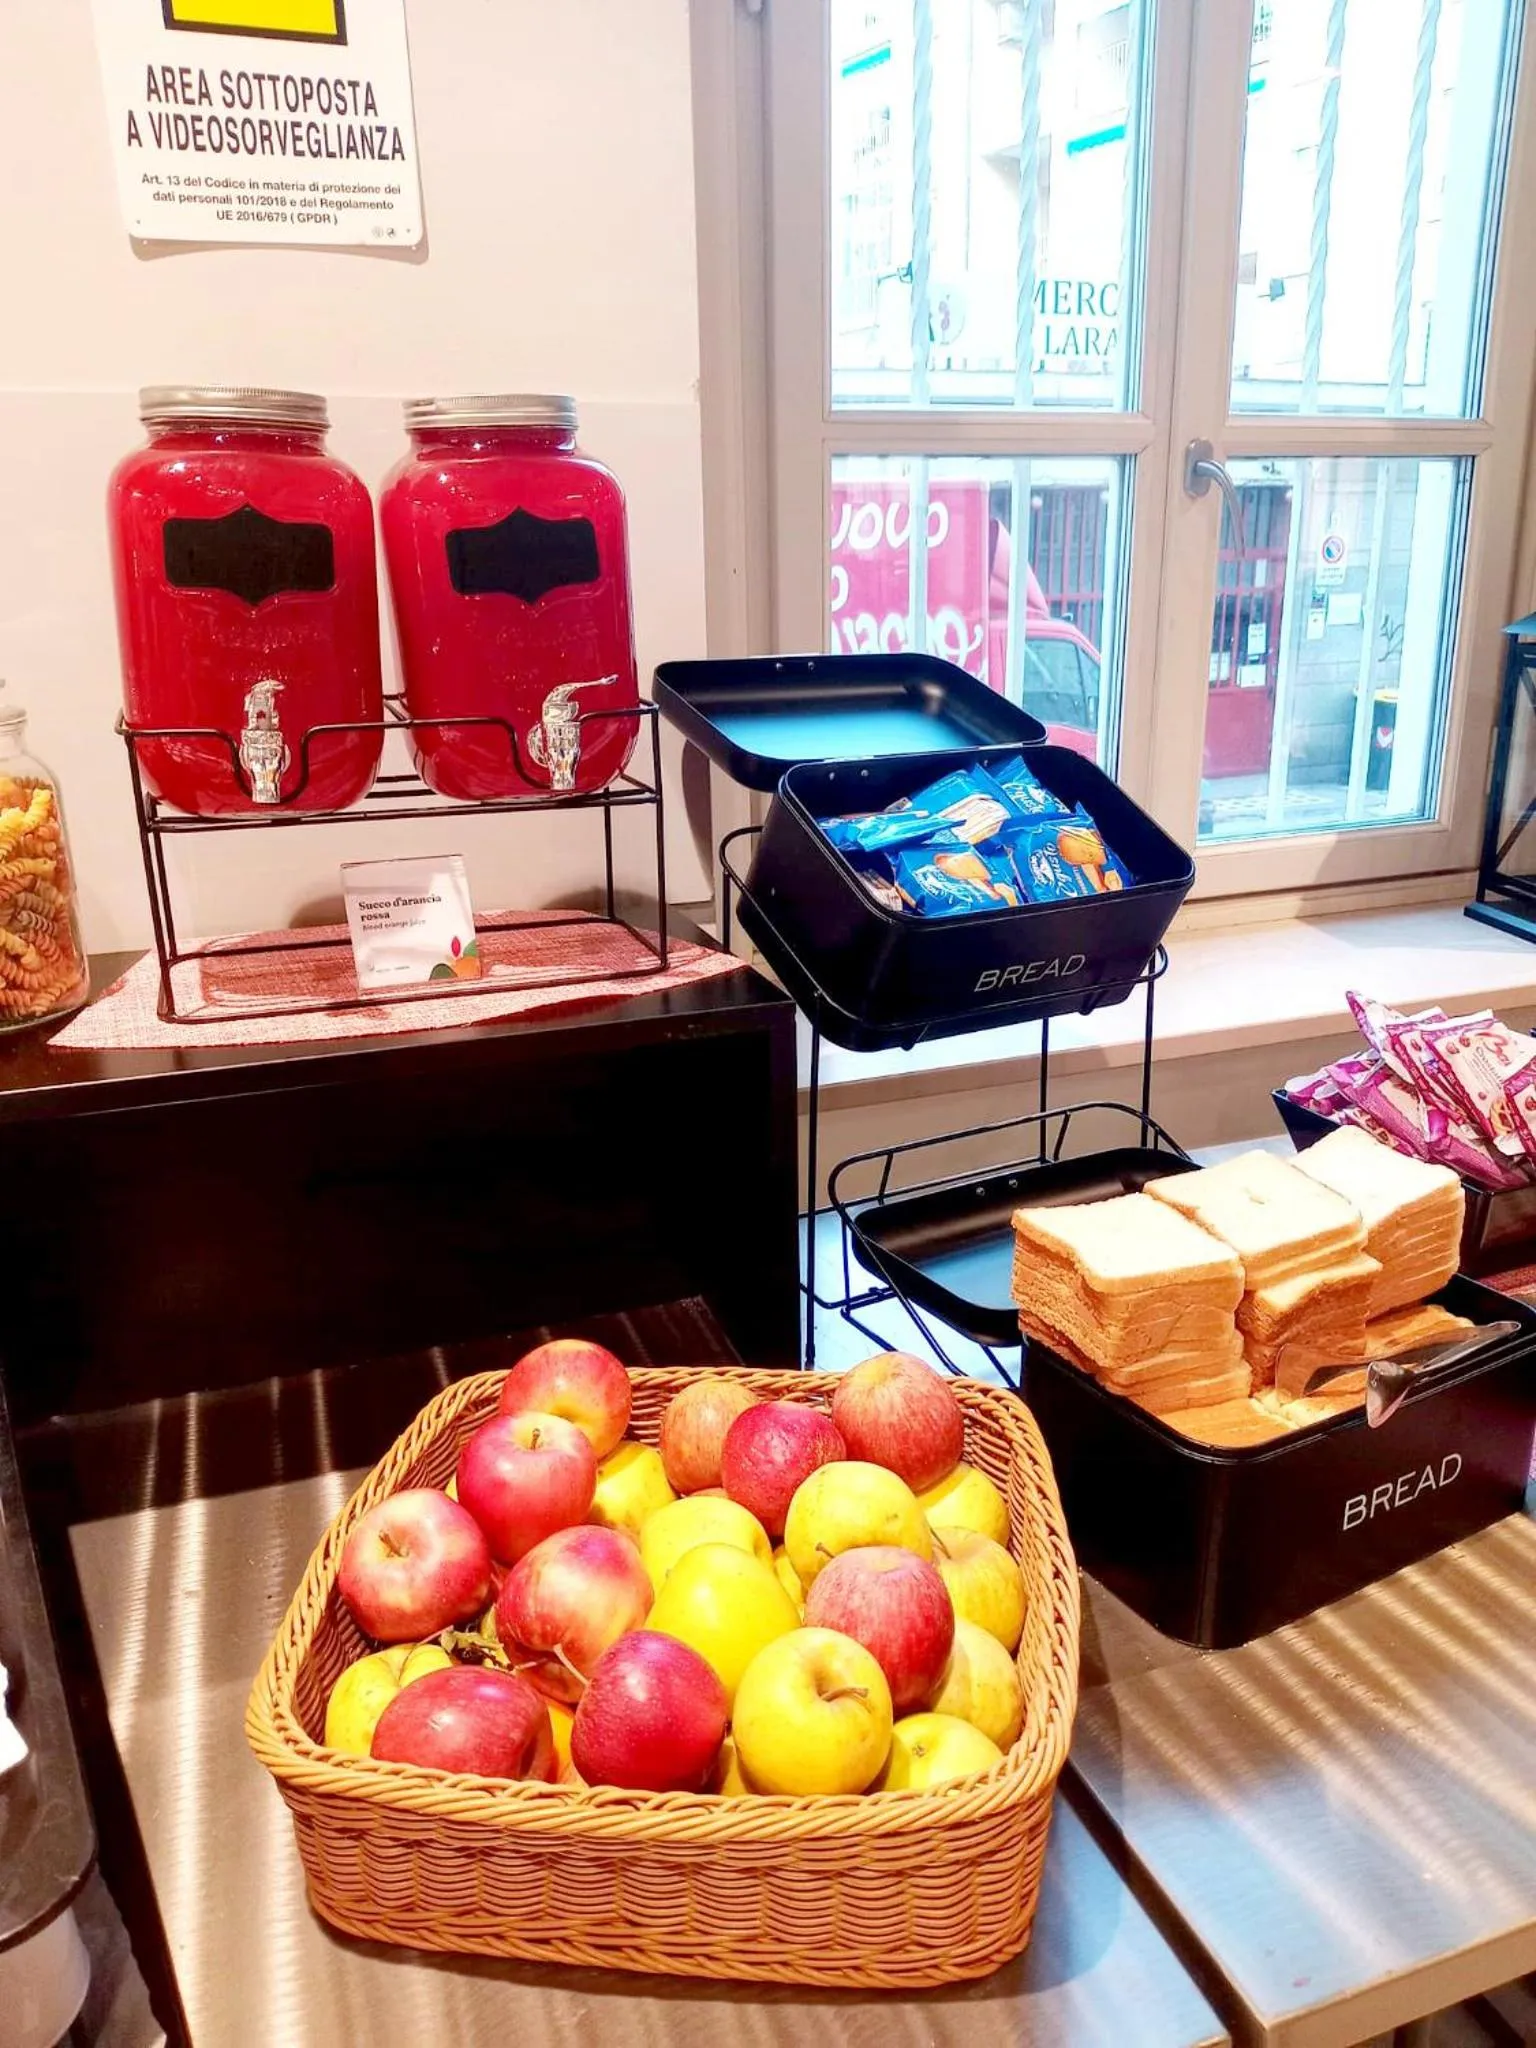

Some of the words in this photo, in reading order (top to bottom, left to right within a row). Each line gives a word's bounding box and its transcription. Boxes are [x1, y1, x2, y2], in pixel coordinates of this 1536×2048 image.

[147, 64, 213, 107] AREA
[221, 70, 379, 117] SOTTOPOSTA
[127, 110, 143, 148] A
[148, 111, 406, 161] VIDEOSORVEGLIANZA
[142, 172, 163, 185] Art.
[167, 175, 181, 186] 13
[183, 176, 202, 187] del
[204, 176, 246, 189] Codice
[249, 178, 260, 190] in
[262, 180, 306, 192] materia
[309, 181, 320, 192] di
[322, 182, 381, 194] protezione
[152, 190, 176, 202] dati
[178, 191, 233, 205] personali
[236, 194, 288, 207] 101/2018
[290, 199, 297, 207] e
[299, 197, 317, 208] del
[320, 197, 394, 211] Regolamento
[216, 209, 233, 221] UE
[236, 210, 288, 223] 2016/679
[359, 900, 391, 911] Succo
[393, 893, 442, 907] d'arancia
[361, 912, 390, 922] rossa
[974, 954, 1086, 992] BREAD
[1342, 1453, 1462, 1531] BREAD
